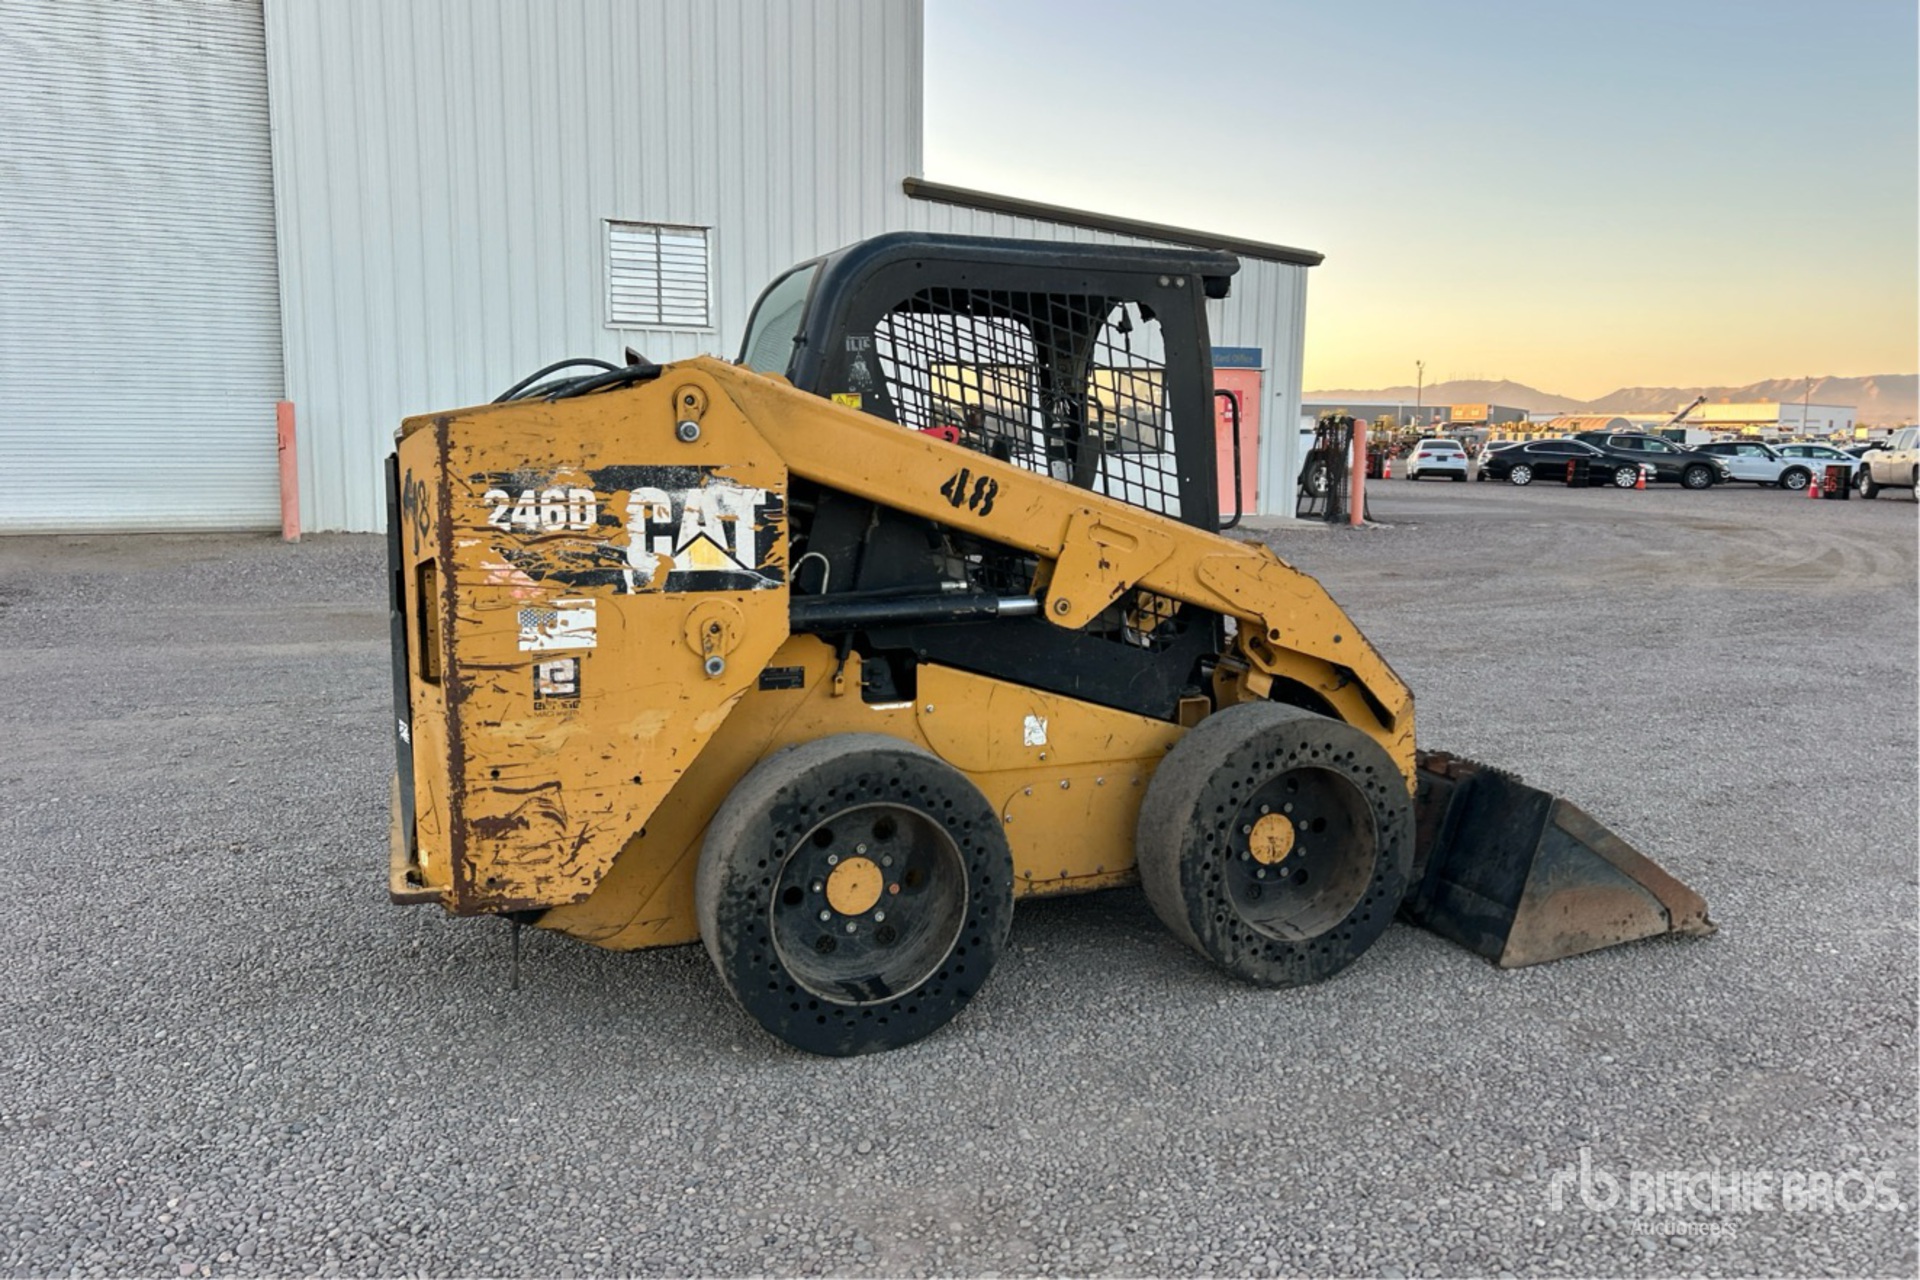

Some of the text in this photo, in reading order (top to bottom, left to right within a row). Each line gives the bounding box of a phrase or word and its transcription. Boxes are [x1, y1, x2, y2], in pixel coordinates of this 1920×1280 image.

[483, 488, 597, 532] 246D
[940, 467, 998, 517] 48
[626, 487, 766, 571] CAT
